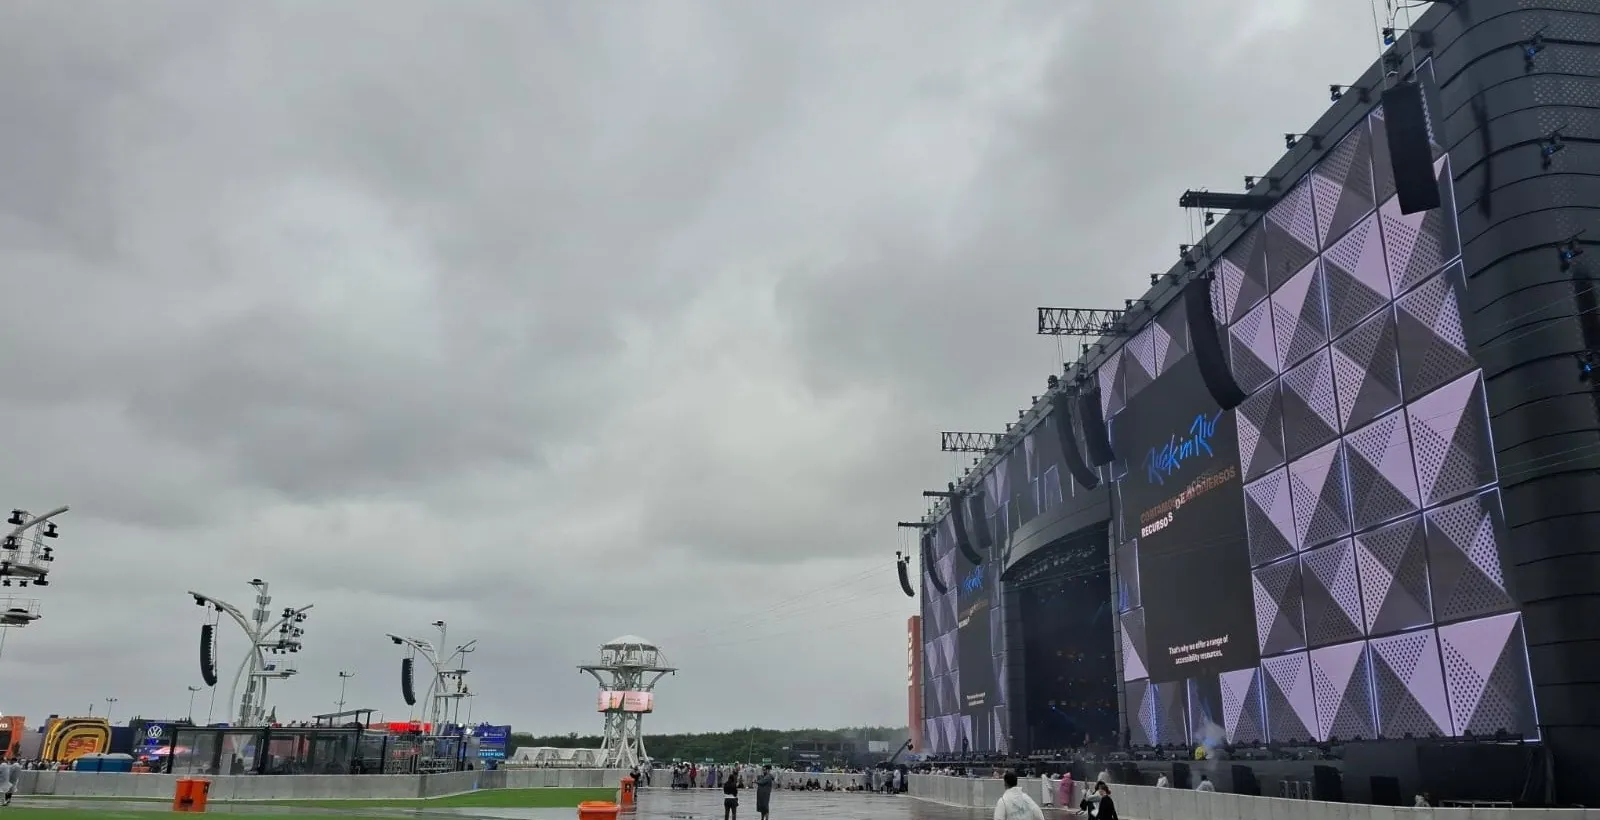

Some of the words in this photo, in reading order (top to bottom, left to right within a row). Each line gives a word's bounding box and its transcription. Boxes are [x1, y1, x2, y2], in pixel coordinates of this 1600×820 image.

[1141, 512, 1174, 538] RECURSOS
[1168, 646, 1180, 654] That's
[1196, 640, 1206, 648] offer
[1210, 638, 1223, 646] range
[1223, 634, 1228, 643] of
[1175, 653, 1200, 664] accessibility
